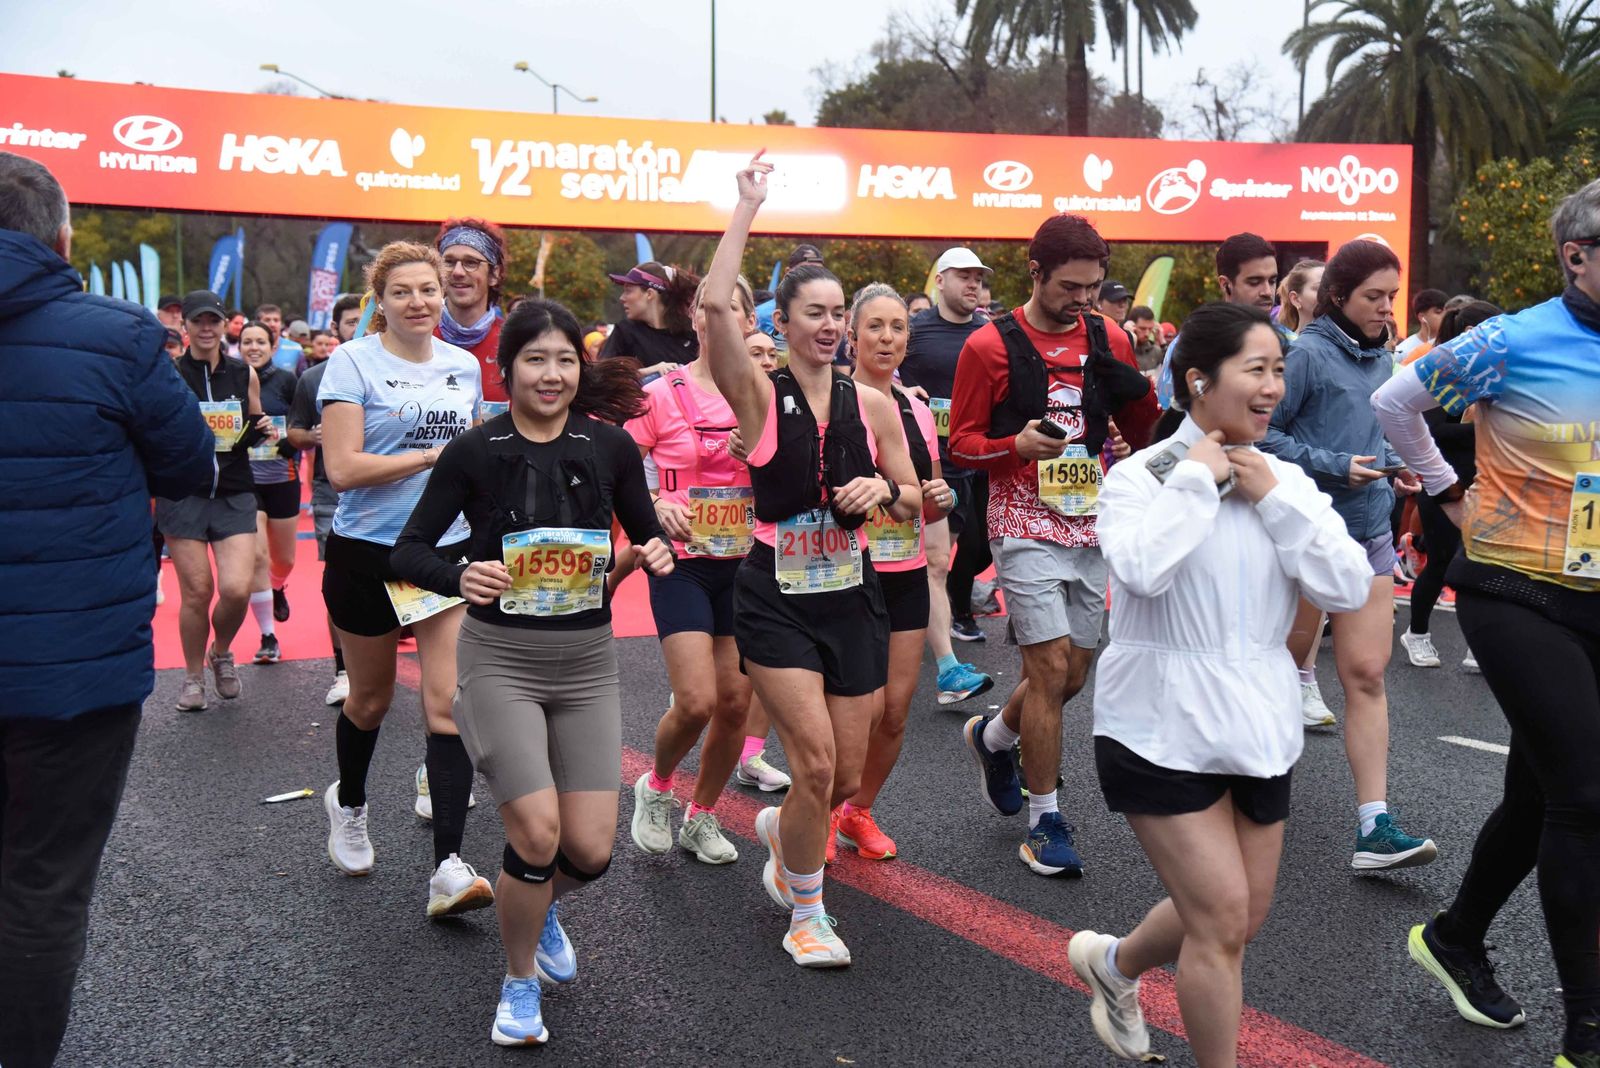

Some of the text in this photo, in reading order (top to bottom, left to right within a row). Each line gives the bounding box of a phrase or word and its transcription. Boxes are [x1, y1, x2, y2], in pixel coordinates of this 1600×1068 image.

[99, 151, 197, 174] HYUNDAI
[218, 133, 348, 177] HOKA
[517, 139, 681, 174] maratón
[560, 167, 686, 203] sevilla
[857, 163, 957, 200] HOKA
[1209, 178, 1294, 201] Sprinter
[972, 192, 1043, 209] HYUNDAI
[1046, 463, 1097, 484] 15936
[695, 503, 747, 526] 18700
[783, 528, 849, 556] 21900
[514, 548, 593, 577] 15596
